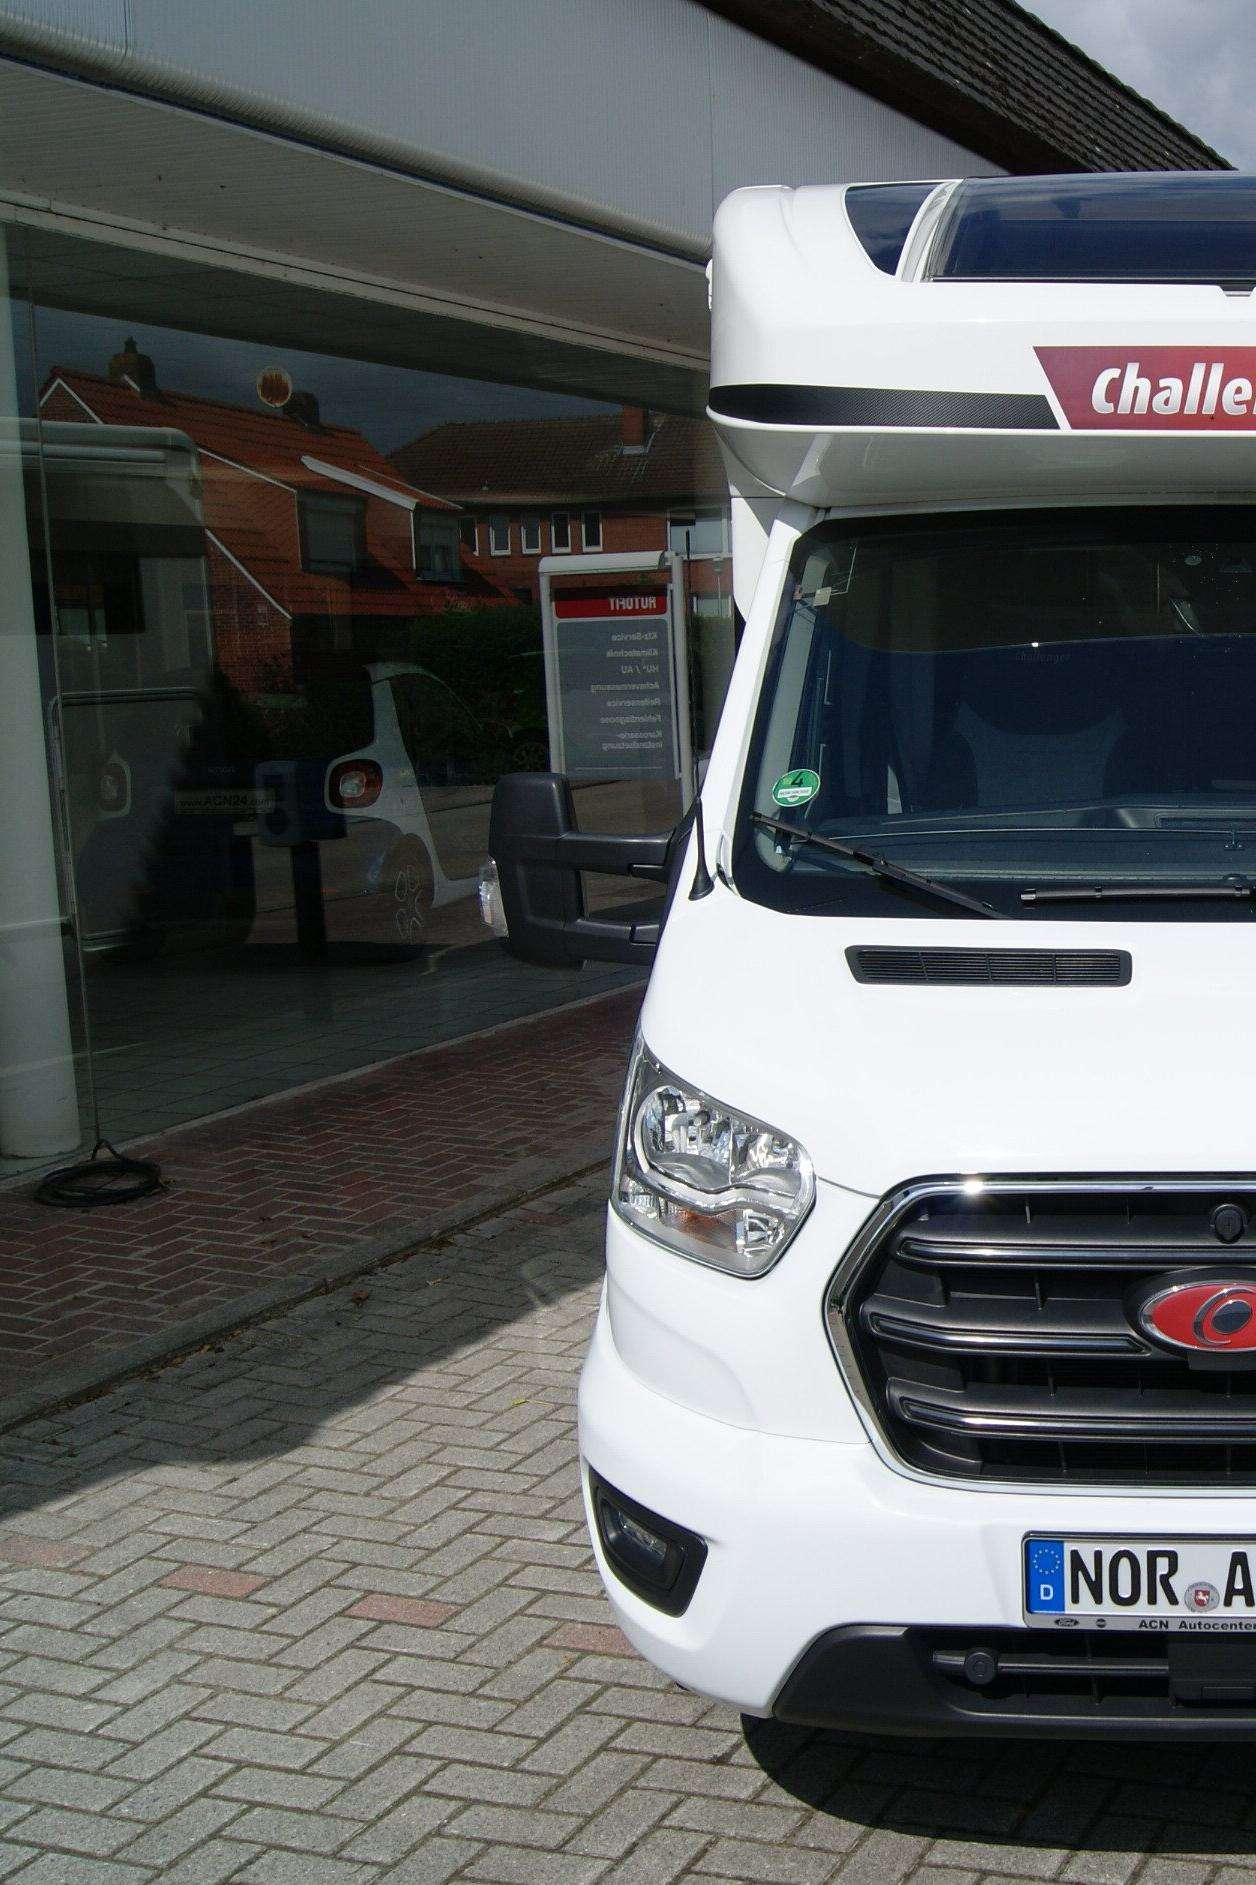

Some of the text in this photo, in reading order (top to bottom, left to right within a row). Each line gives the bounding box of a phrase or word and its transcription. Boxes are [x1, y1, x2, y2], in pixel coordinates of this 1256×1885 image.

[791, 771, 804, 787] 4
[1040, 1585, 1053, 1600] D
[1070, 1548, 1180, 1607] NOR
[1138, 1619, 1169, 1630] ACN
